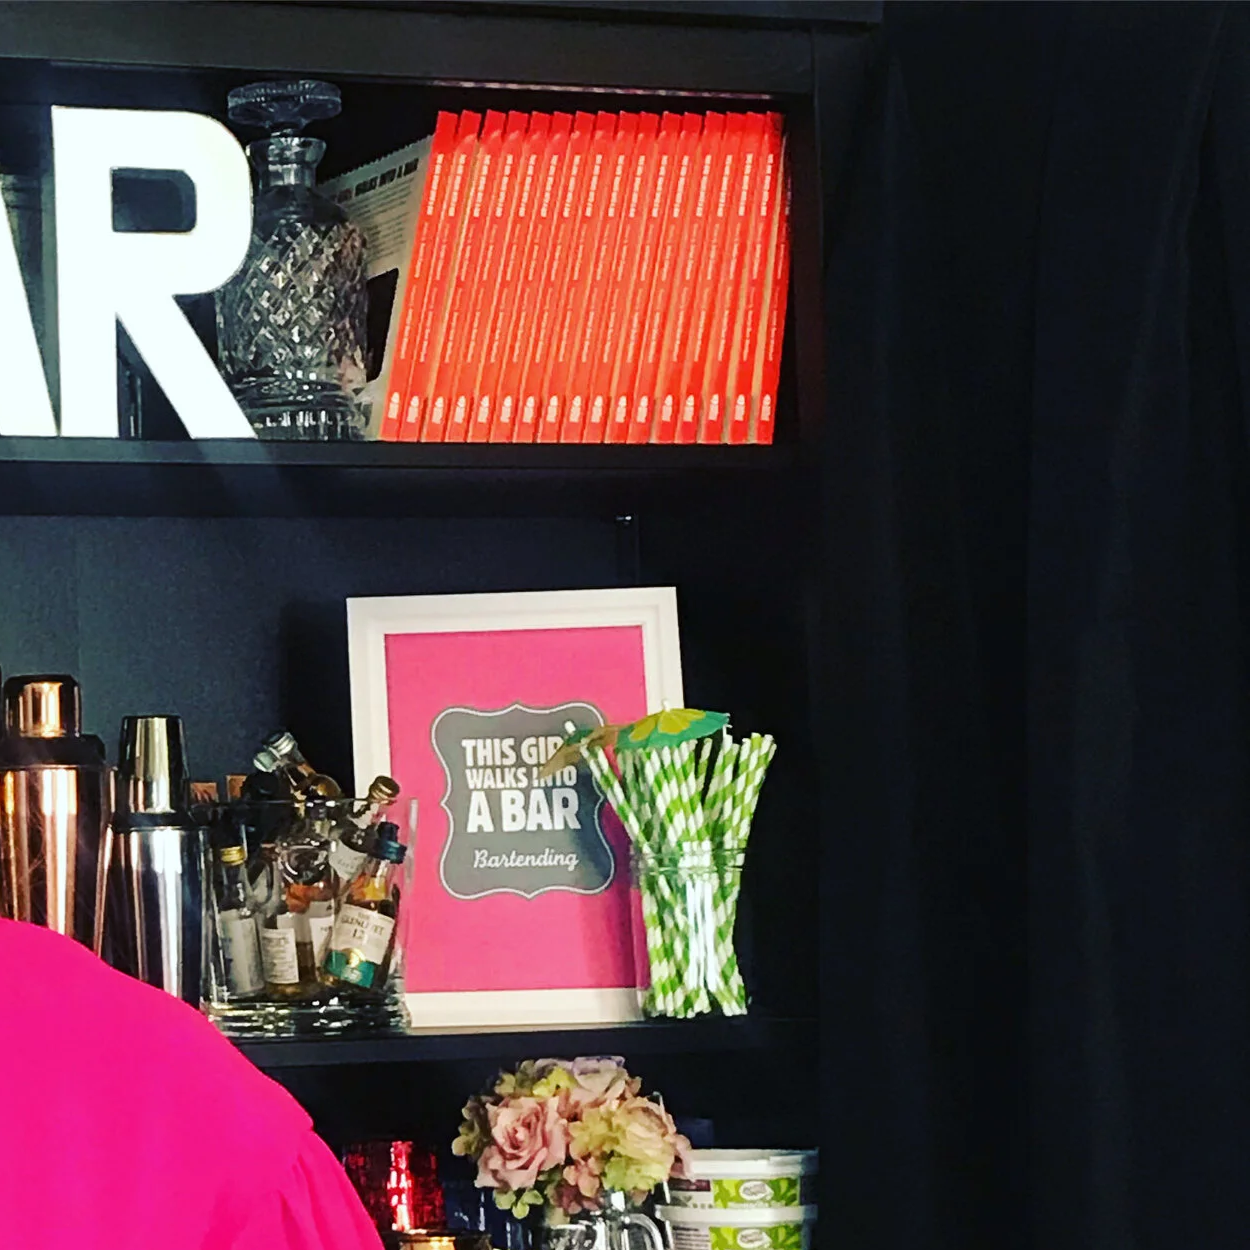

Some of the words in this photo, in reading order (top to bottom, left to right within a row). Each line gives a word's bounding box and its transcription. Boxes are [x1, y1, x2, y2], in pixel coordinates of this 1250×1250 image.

[461, 737, 517, 767] THIS
[520, 735, 565, 765] GI
[465, 766, 528, 790] WALKS
[466, 790, 494, 833] A
[501, 787, 581, 832] BAR
[473, 847, 579, 872] Bartending
